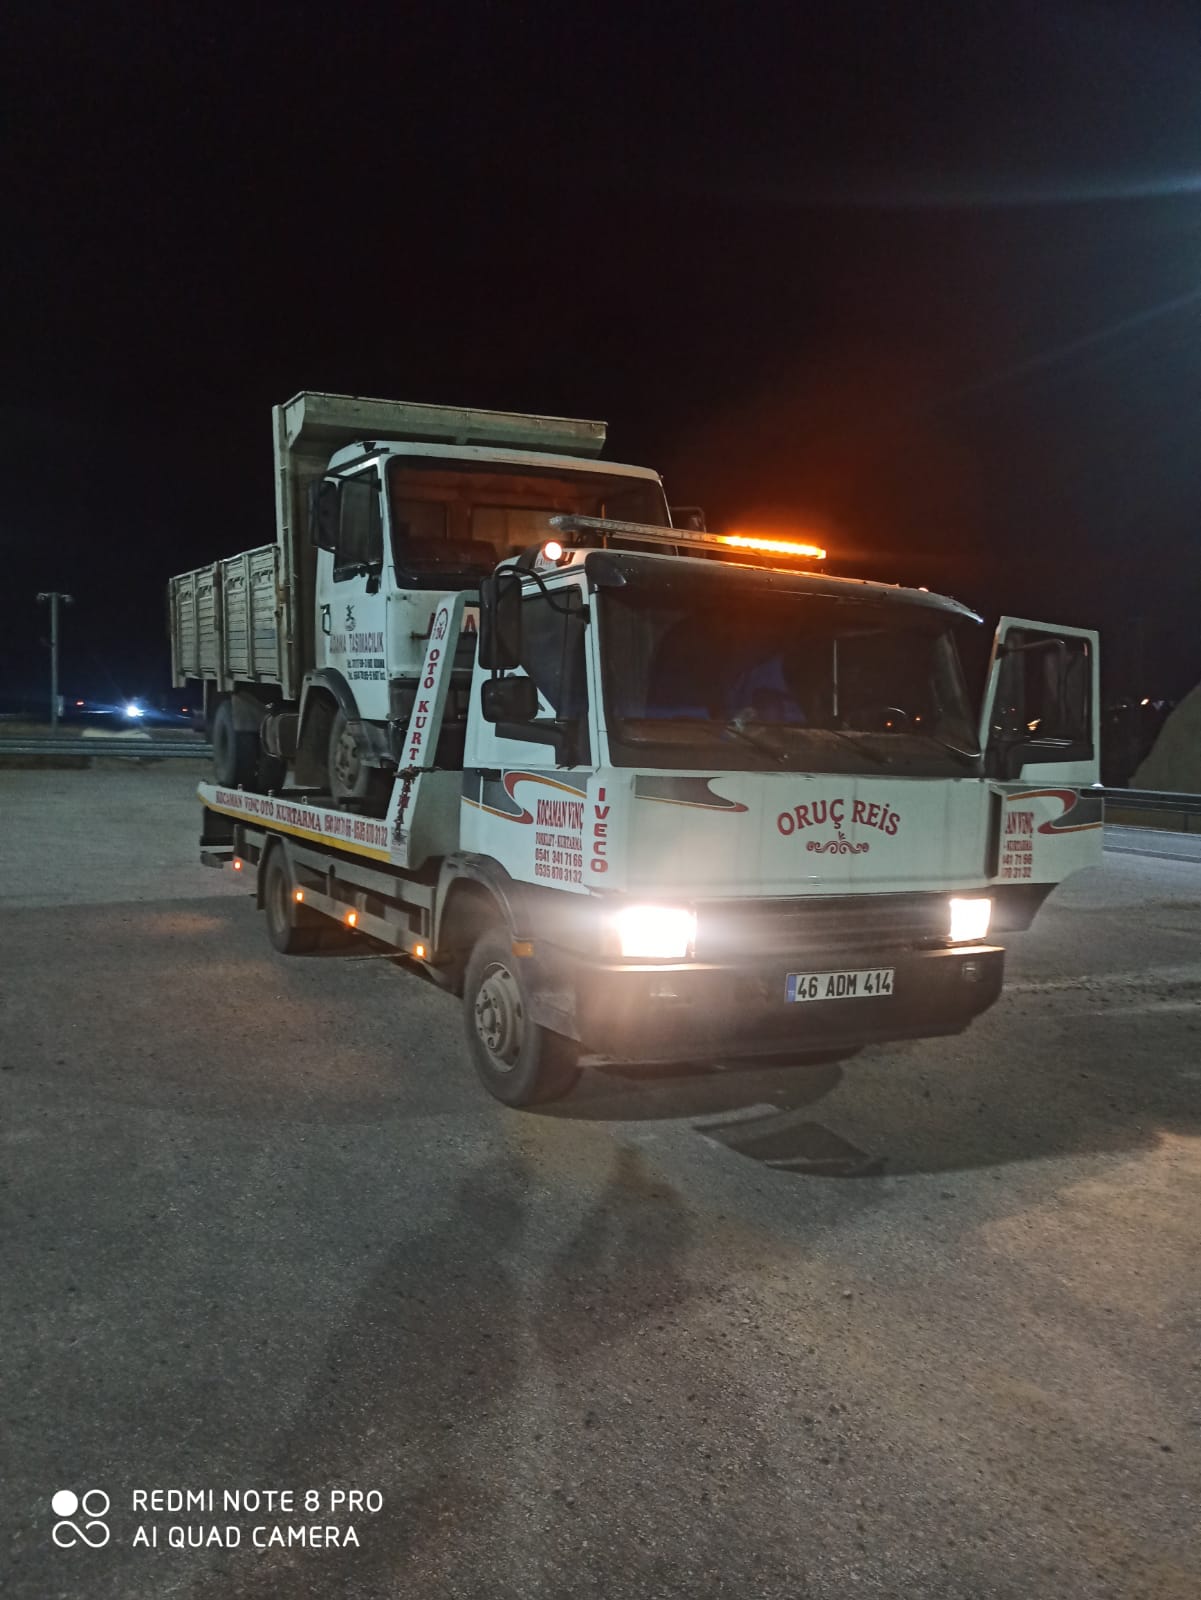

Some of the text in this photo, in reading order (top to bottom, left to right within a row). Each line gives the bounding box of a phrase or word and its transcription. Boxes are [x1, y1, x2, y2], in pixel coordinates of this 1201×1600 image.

[423, 649, 440, 689] OTO
[260, 800, 274, 816] OTO
[276, 804, 322, 832] KURTARMA
[536, 799, 568, 828] KOCAMAN
[777, 799, 844, 836] ORUÇ
[590, 787, 610, 873] IVECO
[535, 848, 583, 868] 0541 341 71 66
[535, 863, 583, 884] 0535 870 31 32
[798, 976, 818, 999] 46
[825, 974, 857, 997] ADM
[863, 972, 891, 994] 414
